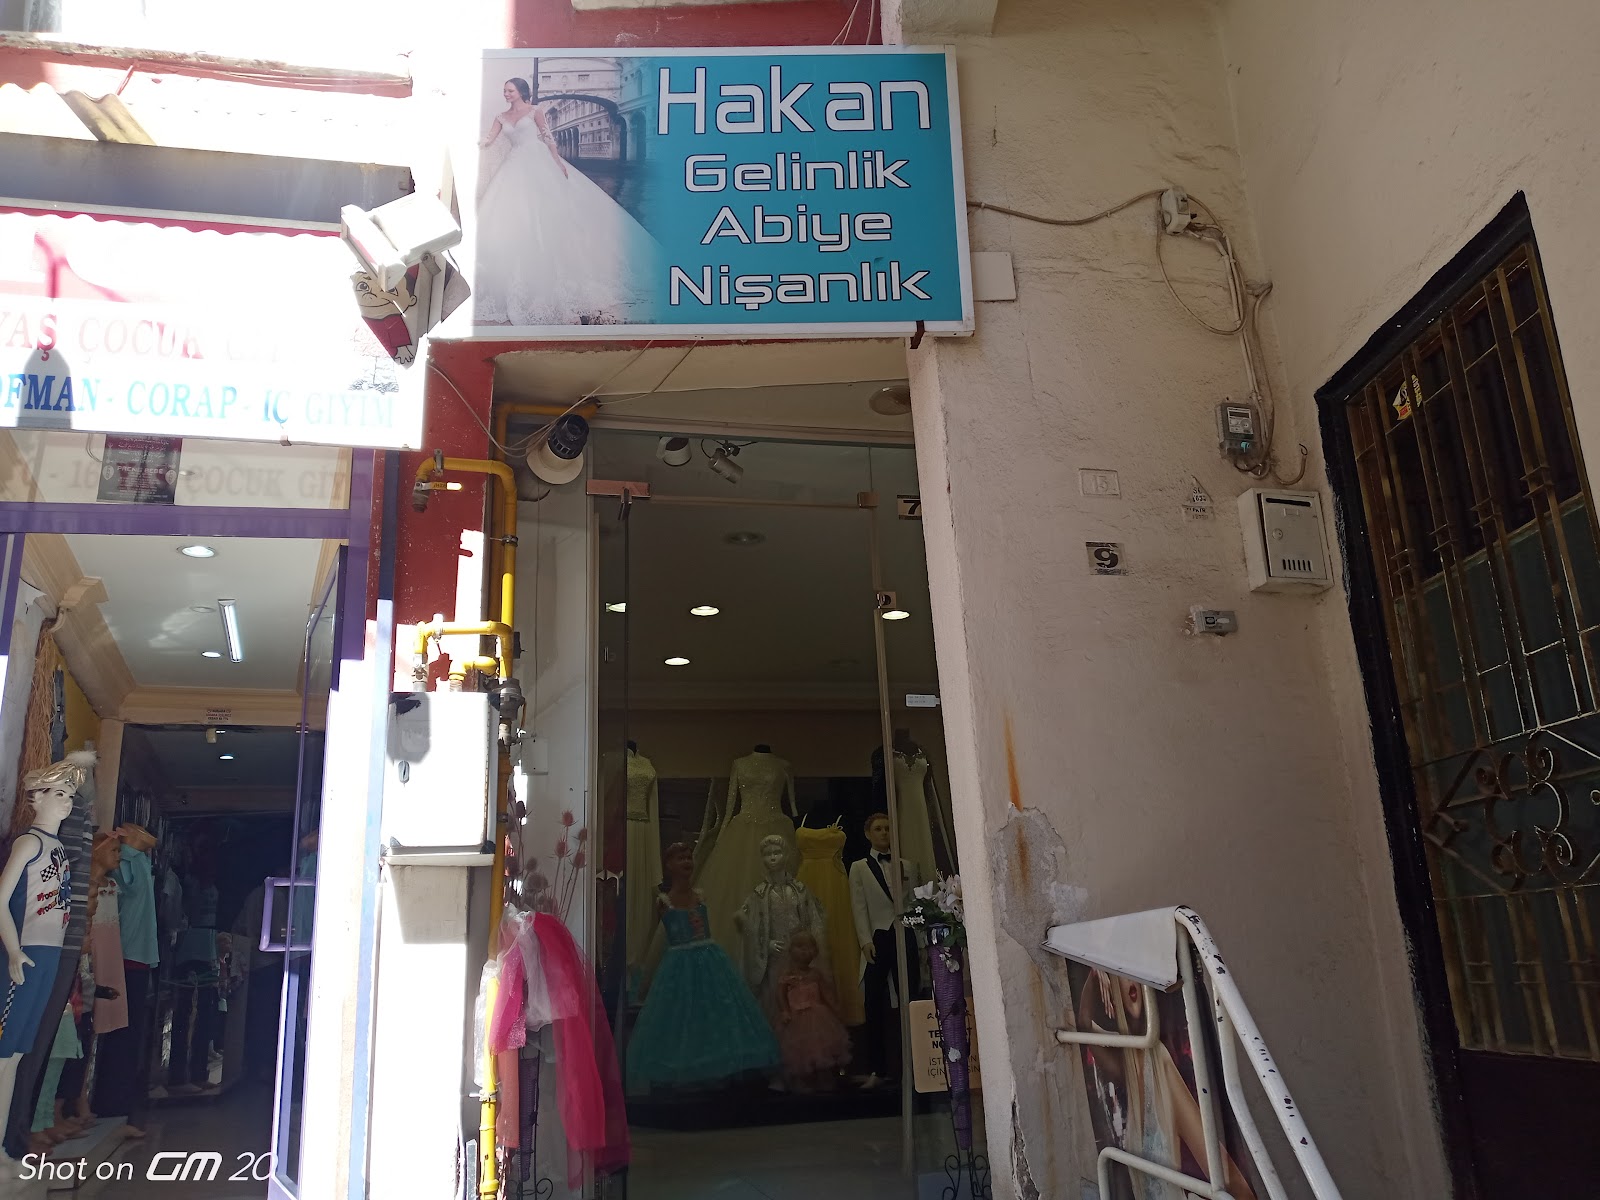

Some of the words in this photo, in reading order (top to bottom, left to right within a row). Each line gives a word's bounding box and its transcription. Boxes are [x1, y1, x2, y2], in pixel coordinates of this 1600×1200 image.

[658, 65, 932, 136] Hakan
[684, 150, 911, 193] Gelinlik
[700, 205, 892, 253] Abiye
[669, 261, 933, 311] Nişanlık
[0, 373, 101, 411] FMAN
[127, 380, 238, 419] CORAP
[903, 500, 921, 515] 7
[1094, 548, 1119, 569] 9
